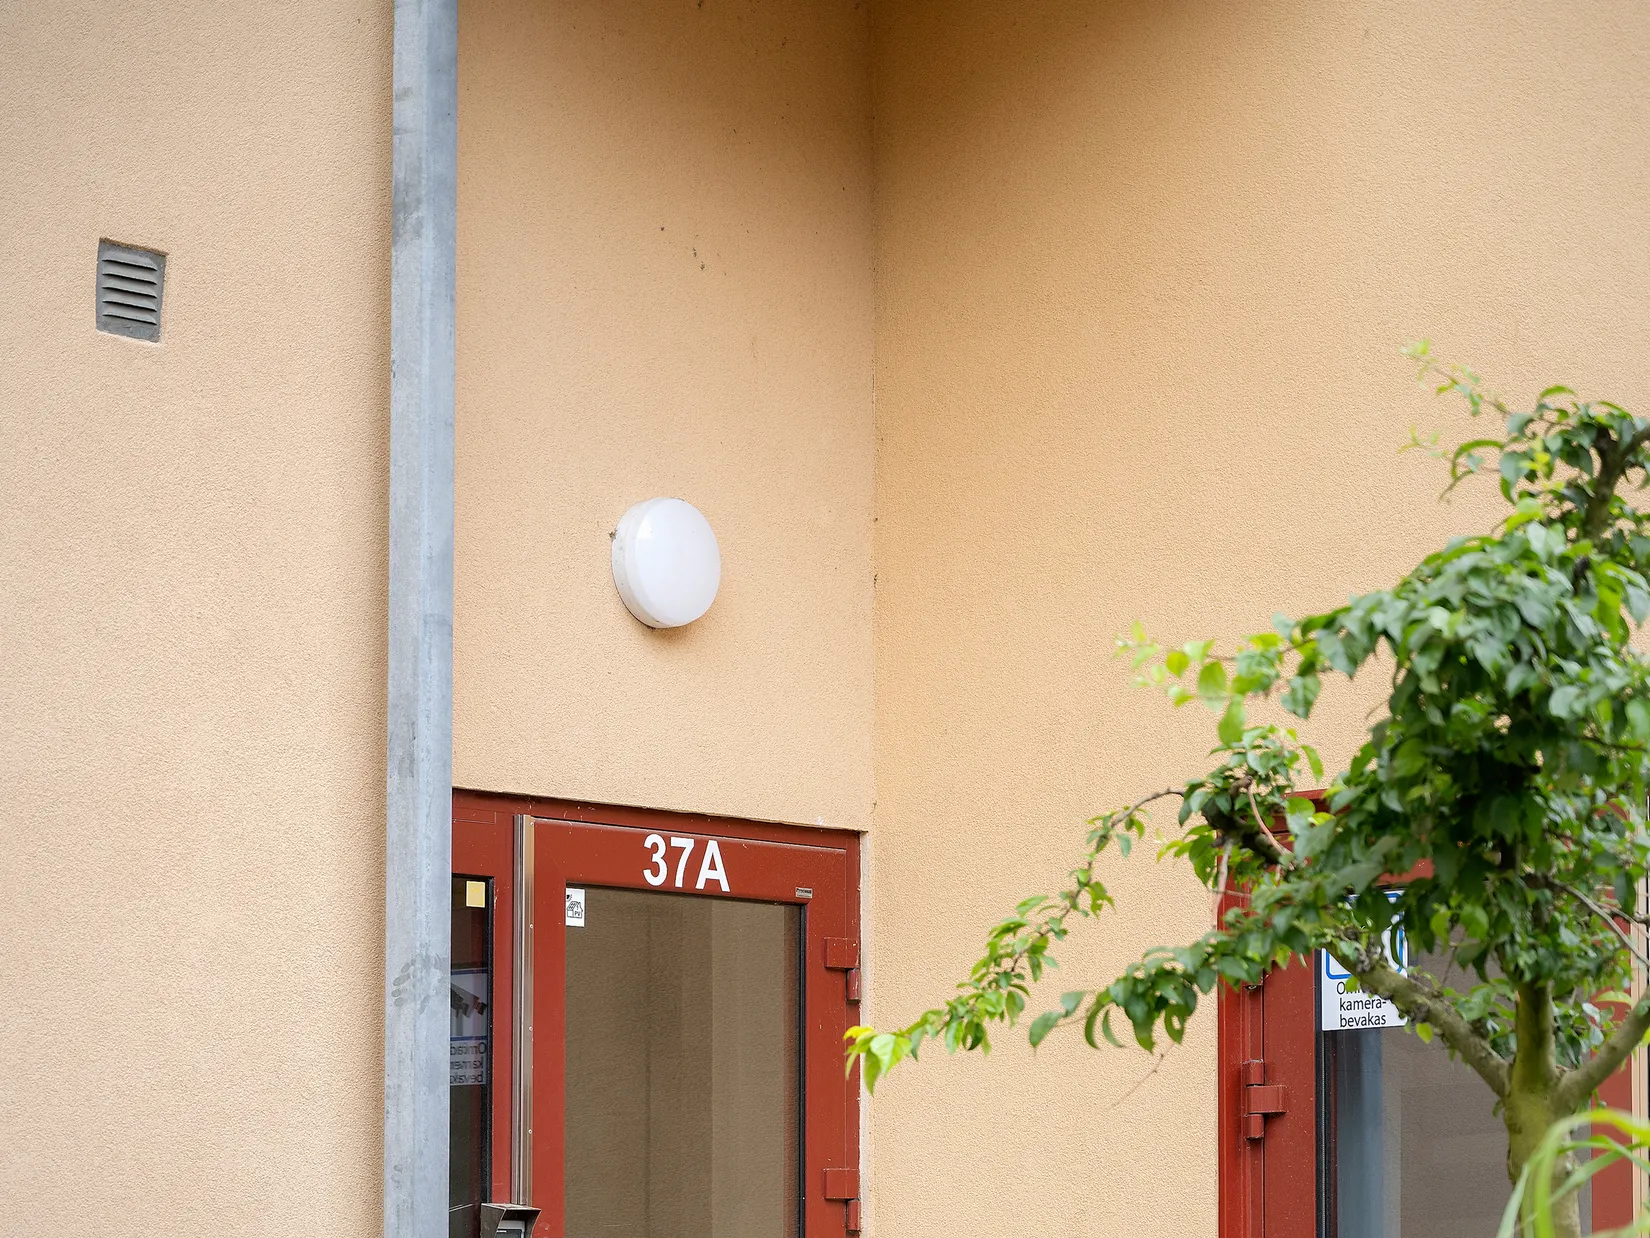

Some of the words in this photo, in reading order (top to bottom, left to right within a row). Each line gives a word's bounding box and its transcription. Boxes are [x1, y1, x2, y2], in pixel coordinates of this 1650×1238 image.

[643, 833, 731, 892] 37A
[1339, 997, 1387, 1011] kamera-
[1339, 1012, 1386, 1028] bevakas
